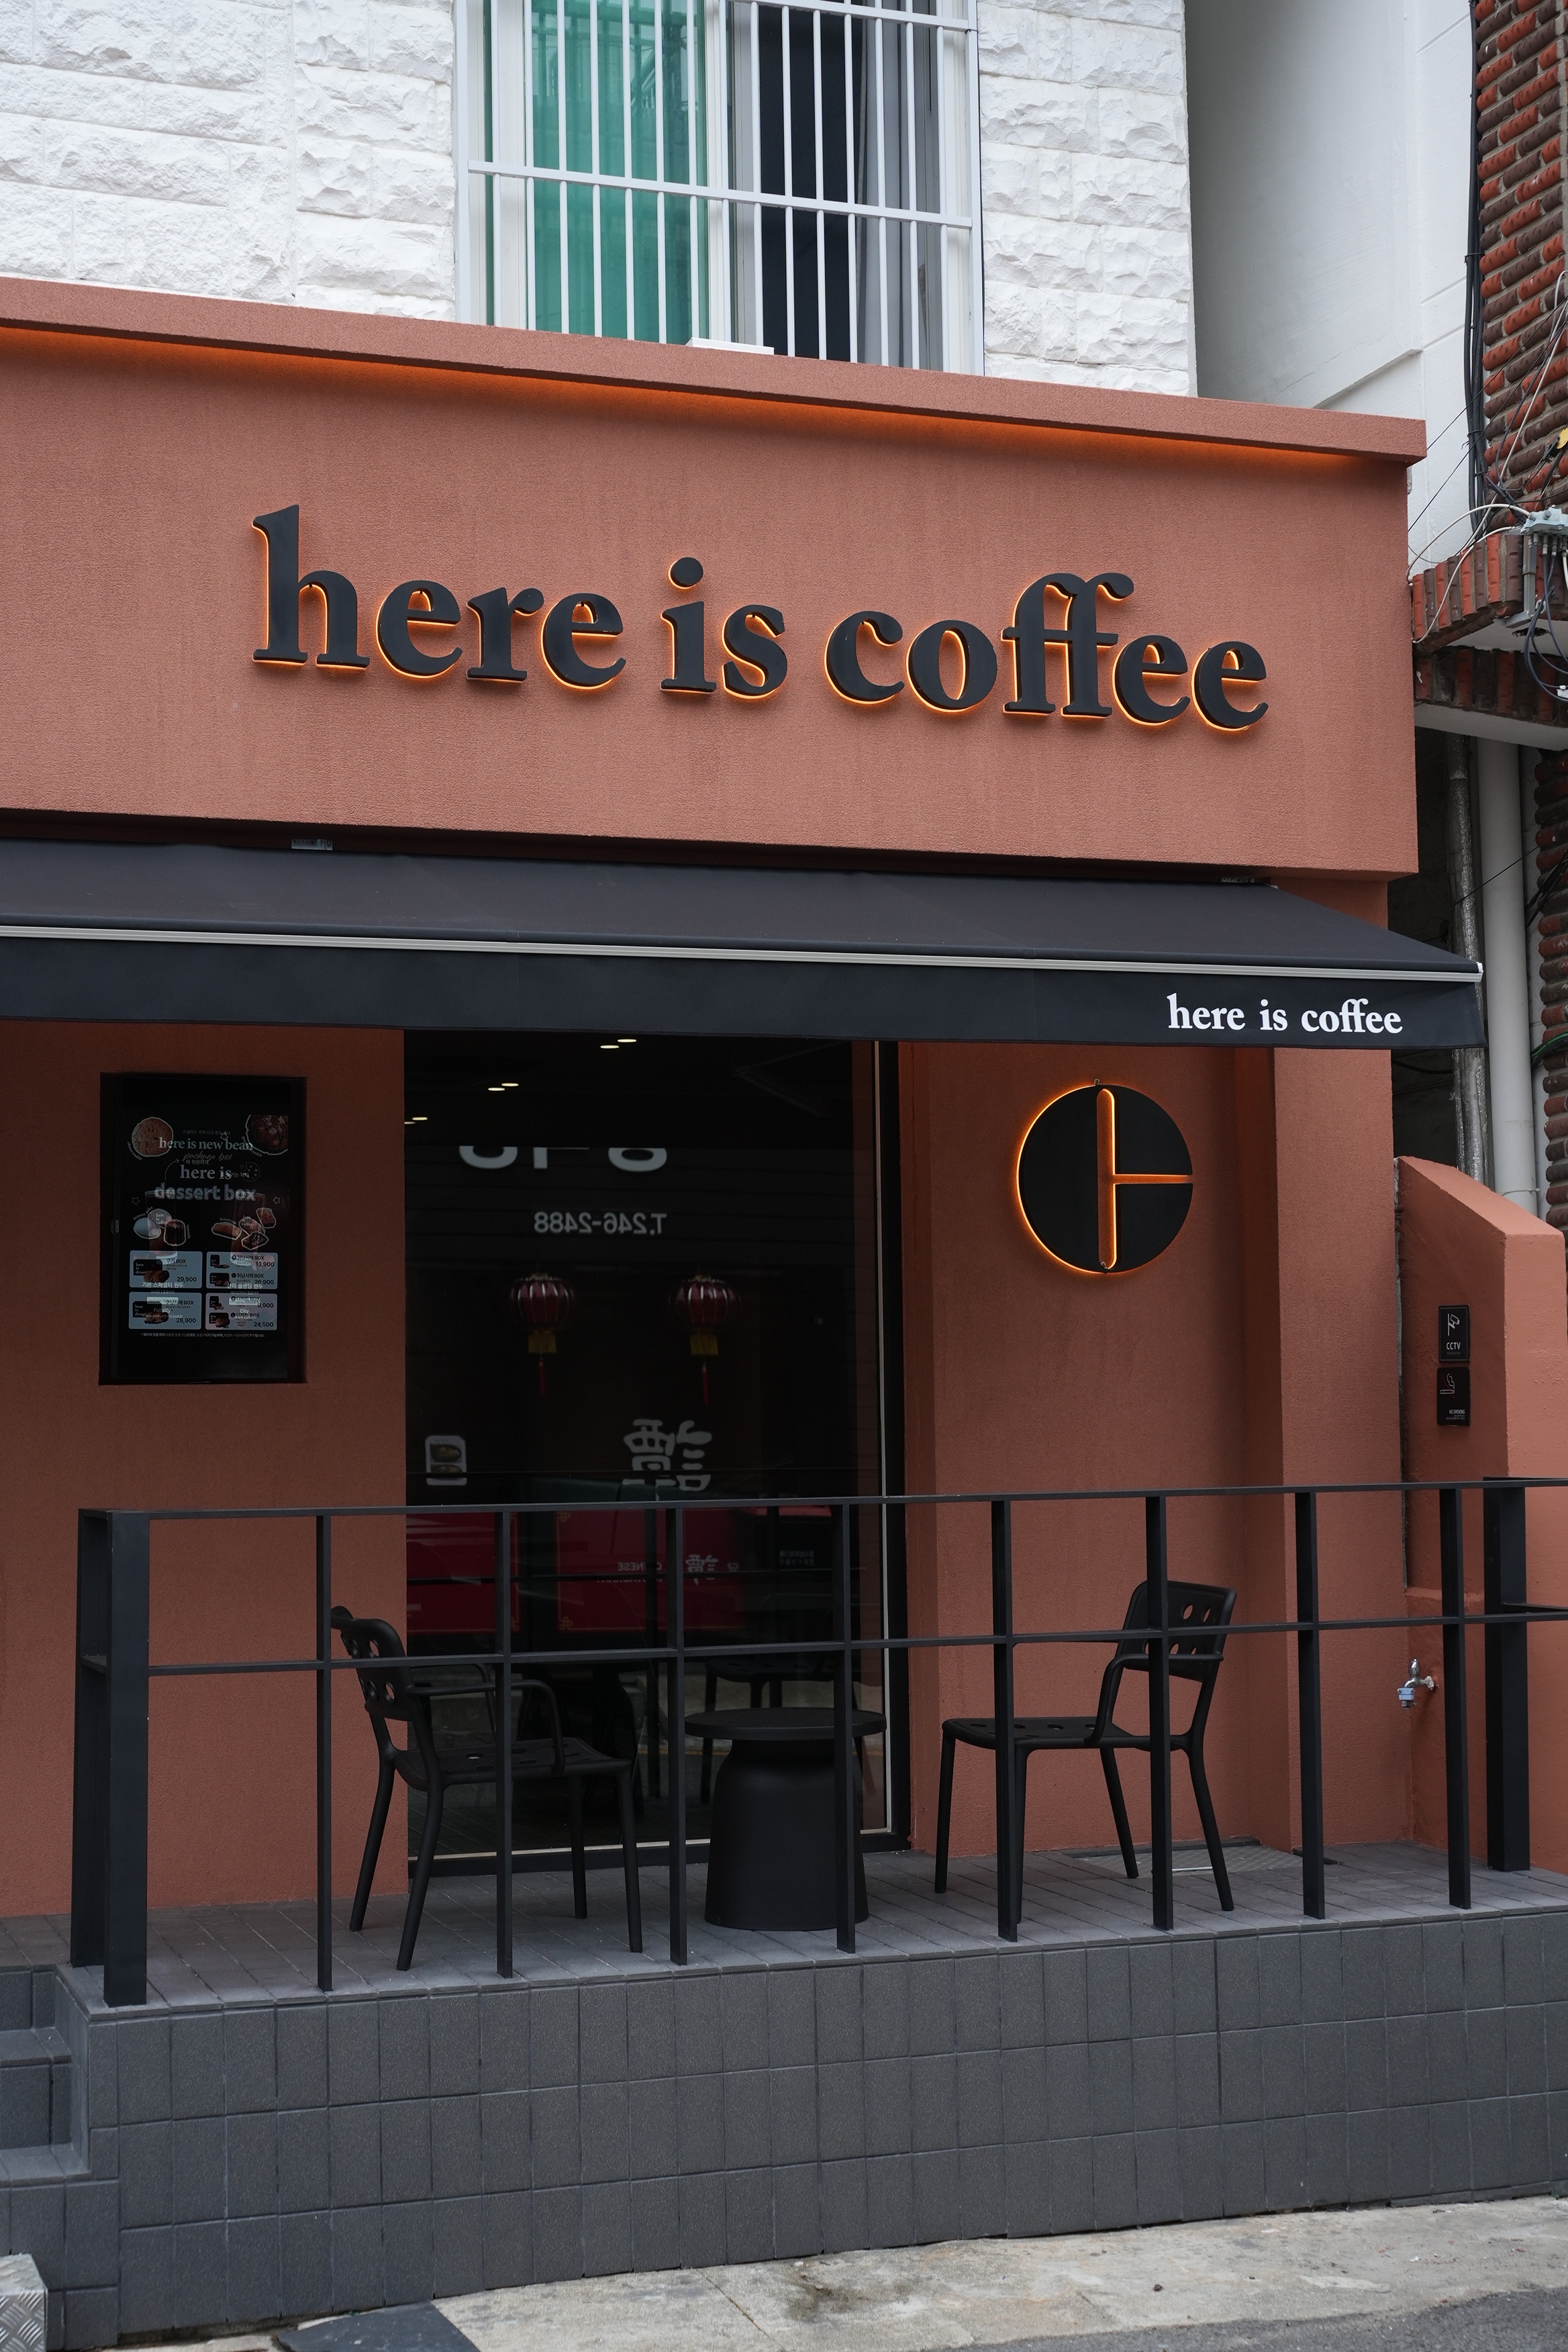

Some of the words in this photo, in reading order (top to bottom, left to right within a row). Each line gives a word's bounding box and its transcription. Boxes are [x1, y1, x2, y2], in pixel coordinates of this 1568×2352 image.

[251, 504, 627, 690] here
[660, 556, 788, 699] is
[824, 572, 1269, 731] coffee
[1166, 992, 1246, 1030] here
[1259, 998, 1288, 1031] is
[1301, 997, 1404, 1034] coffee
[158, 1136, 185, 1148] here
[187, 1138, 197, 1149] is
[199, 1141, 224, 1150] new
[182, 1150, 216, 1162] package
[218, 1153, 233, 1161] box
[180, 1165, 215, 1179] here
[219, 1166, 232, 1180] is
[154, 1182, 221, 1201] dessert
[224, 1183, 256, 1202] box
[1446, 1342, 1461, 1350] CCTV
